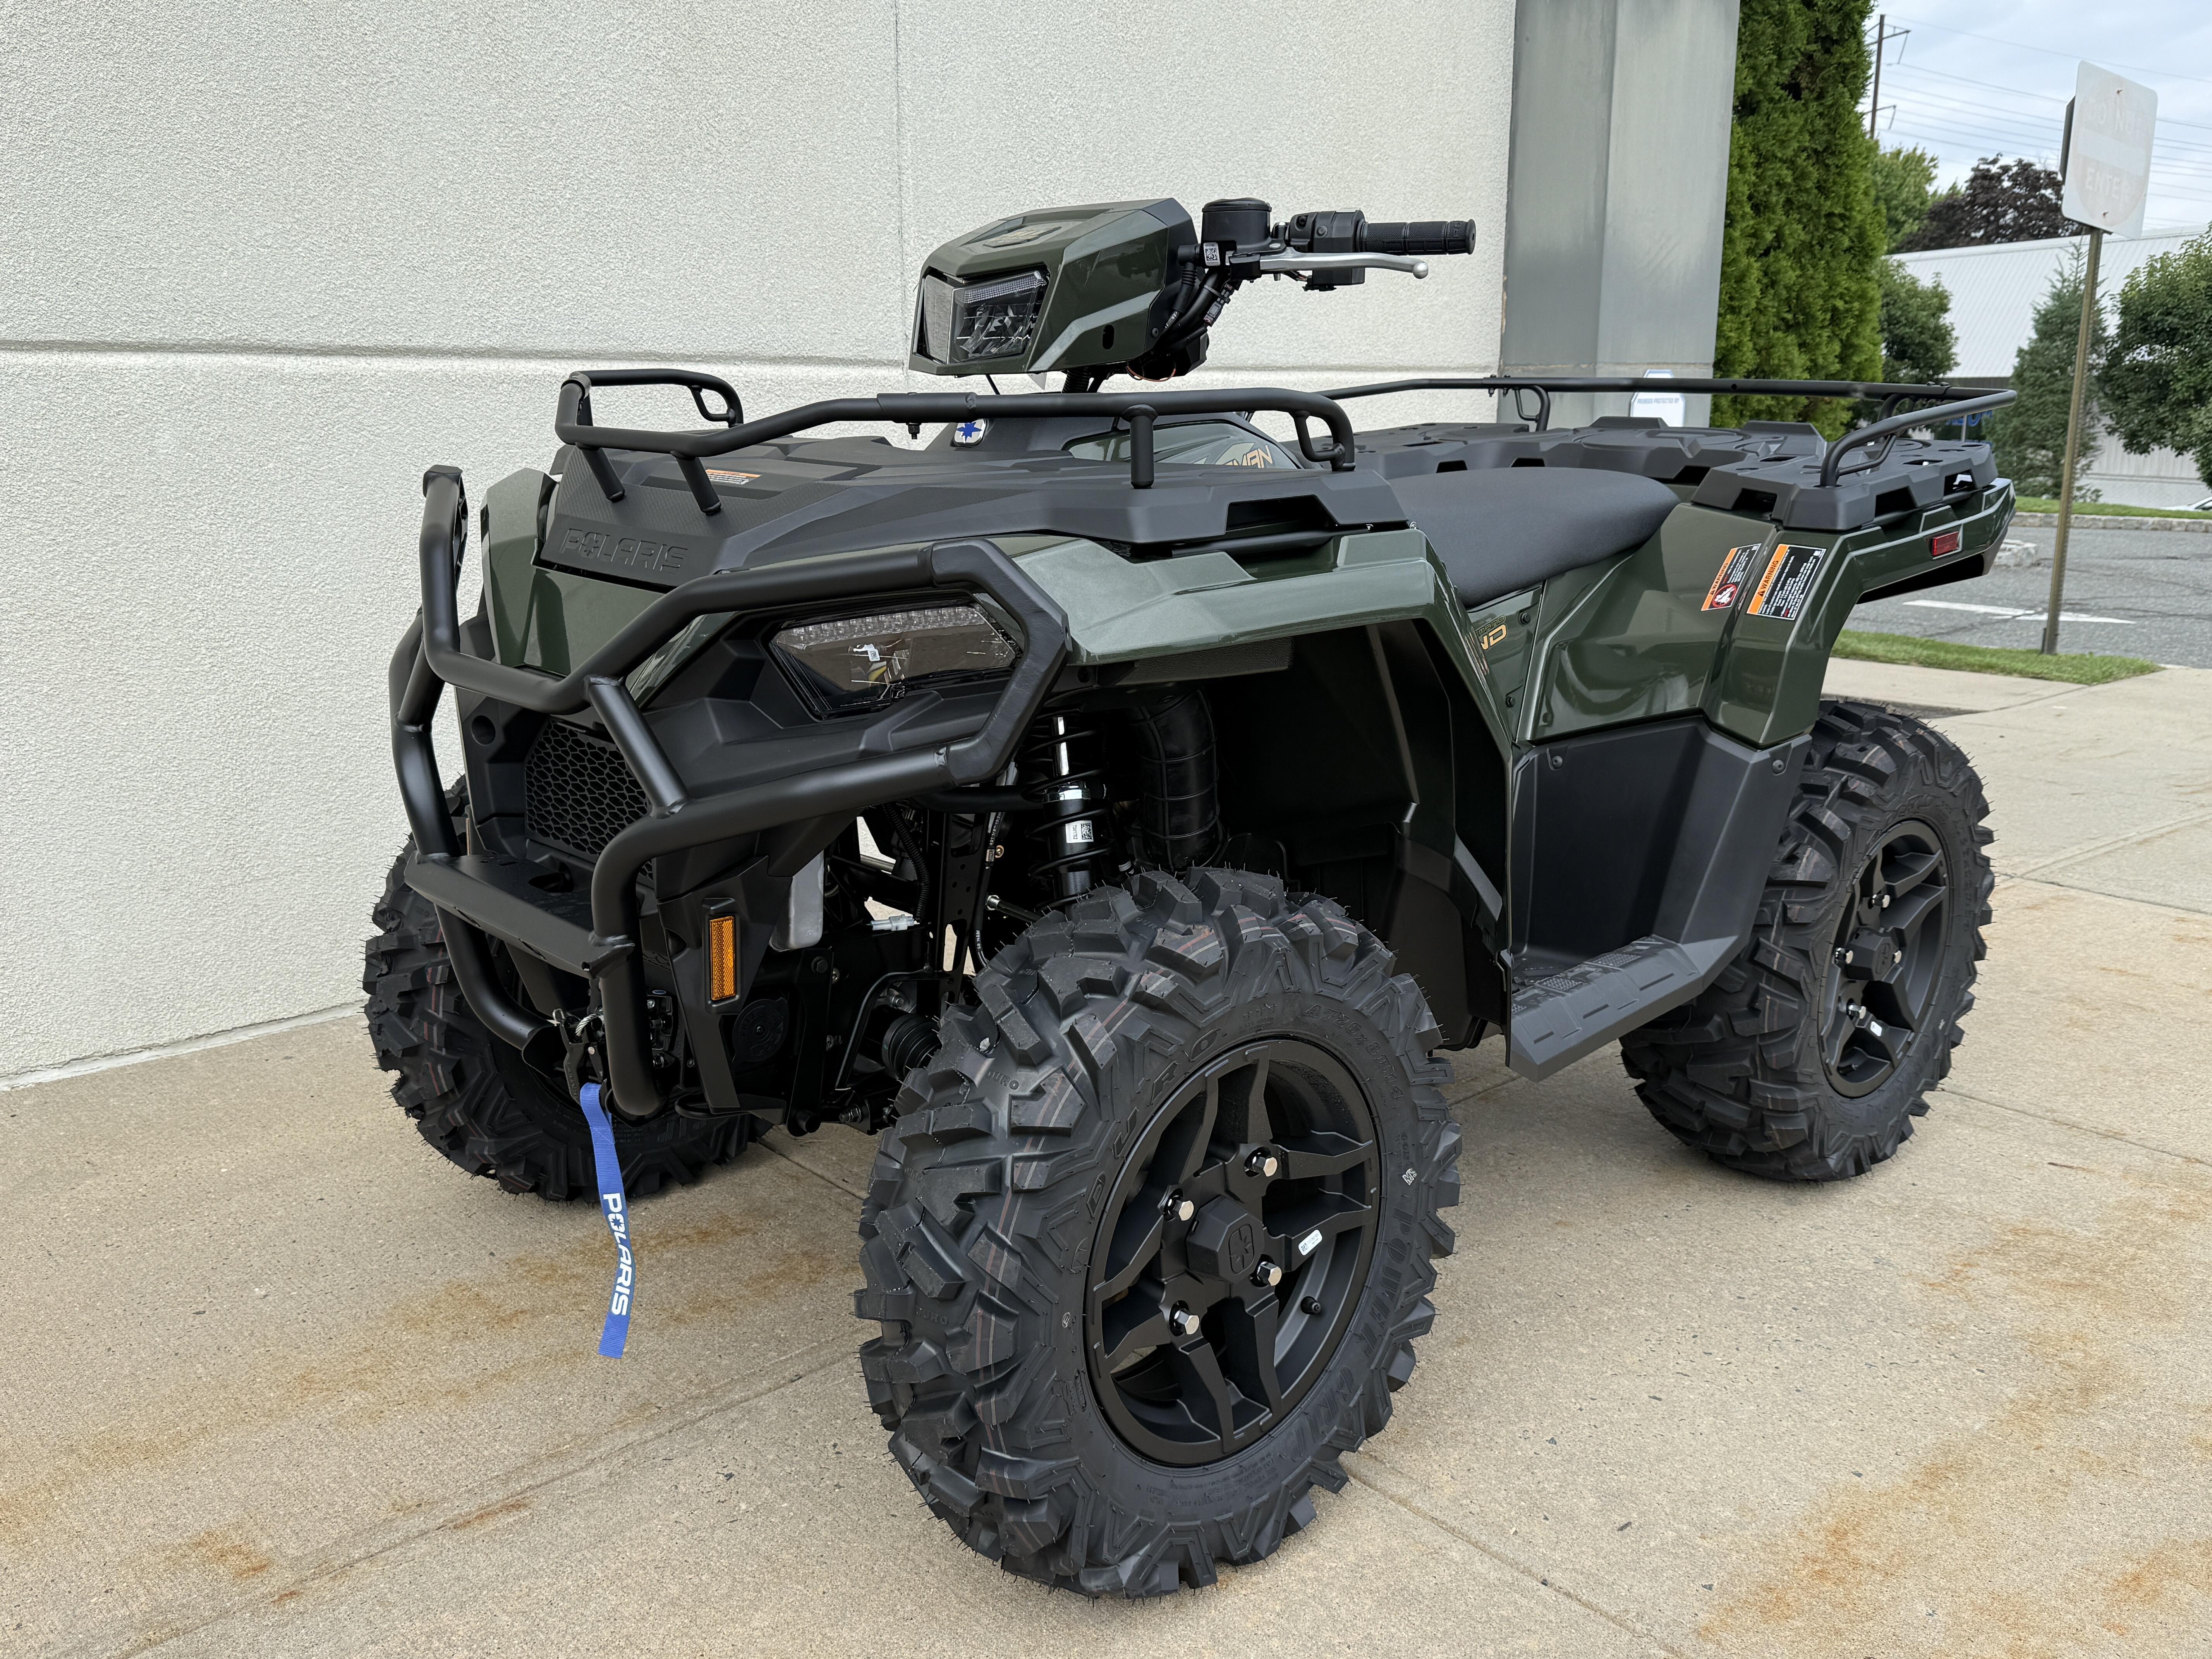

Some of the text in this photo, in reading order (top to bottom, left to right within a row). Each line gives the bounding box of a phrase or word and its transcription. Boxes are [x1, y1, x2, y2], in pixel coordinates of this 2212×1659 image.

[559, 528, 689, 574] POLARIS
[1712, 562, 1728, 589] WARNING
[1762, 560, 1779, 589] WARNING
[986, 1070, 1019, 1090] DURO
[1087, 1029, 1218, 1219] DURO
[603, 1193, 632, 1316] POLARIS
[915, 1305, 949, 1326] DURO
[1291, 1207, 1413, 1463] POWER GRIP
